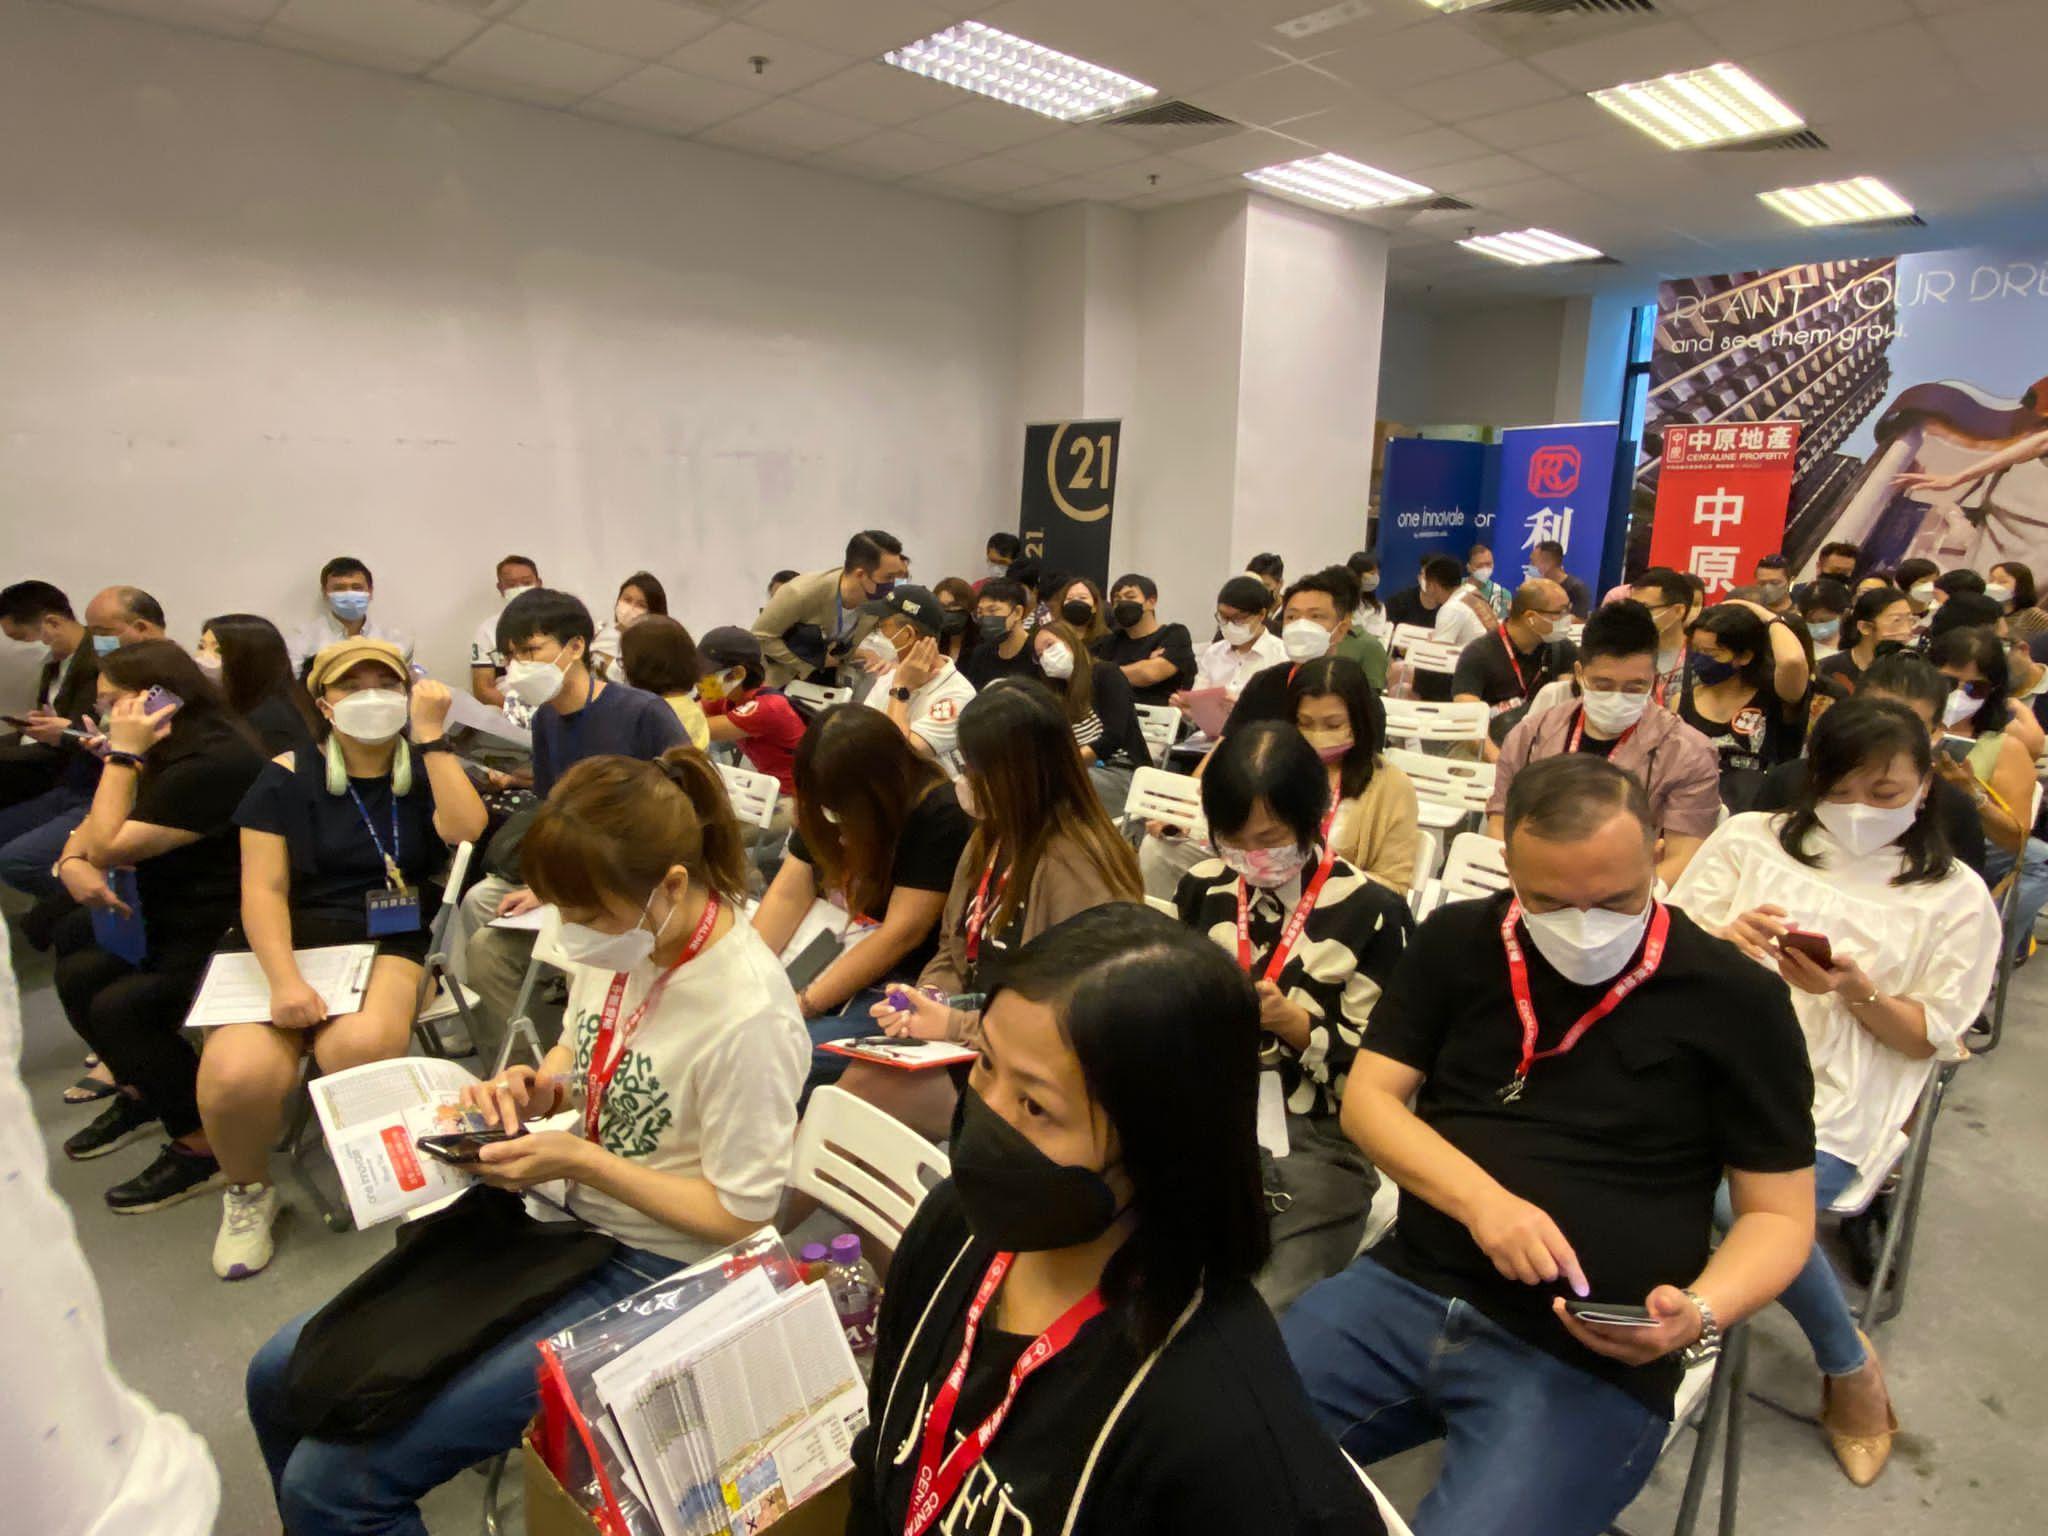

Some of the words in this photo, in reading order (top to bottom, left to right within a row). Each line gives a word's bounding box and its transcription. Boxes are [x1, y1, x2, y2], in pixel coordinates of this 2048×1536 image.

[1673, 283, 1813, 327] PLANT
[1826, 271, 1955, 312] YOUR
[1671, 330, 1714, 353] and
[1720, 333, 1762, 351] see
[1771, 324, 1831, 347] them
[1688, 426, 1793, 452] 中原地產
[1068, 435, 1112, 489] 21
[1686, 452, 1737, 462] CENTALINE
[1739, 451, 1790, 461] PROPERTY
[1397, 512, 1420, 528] one
[1025, 531, 1045, 559] 21
[1688, 487, 1744, 593] 中原
